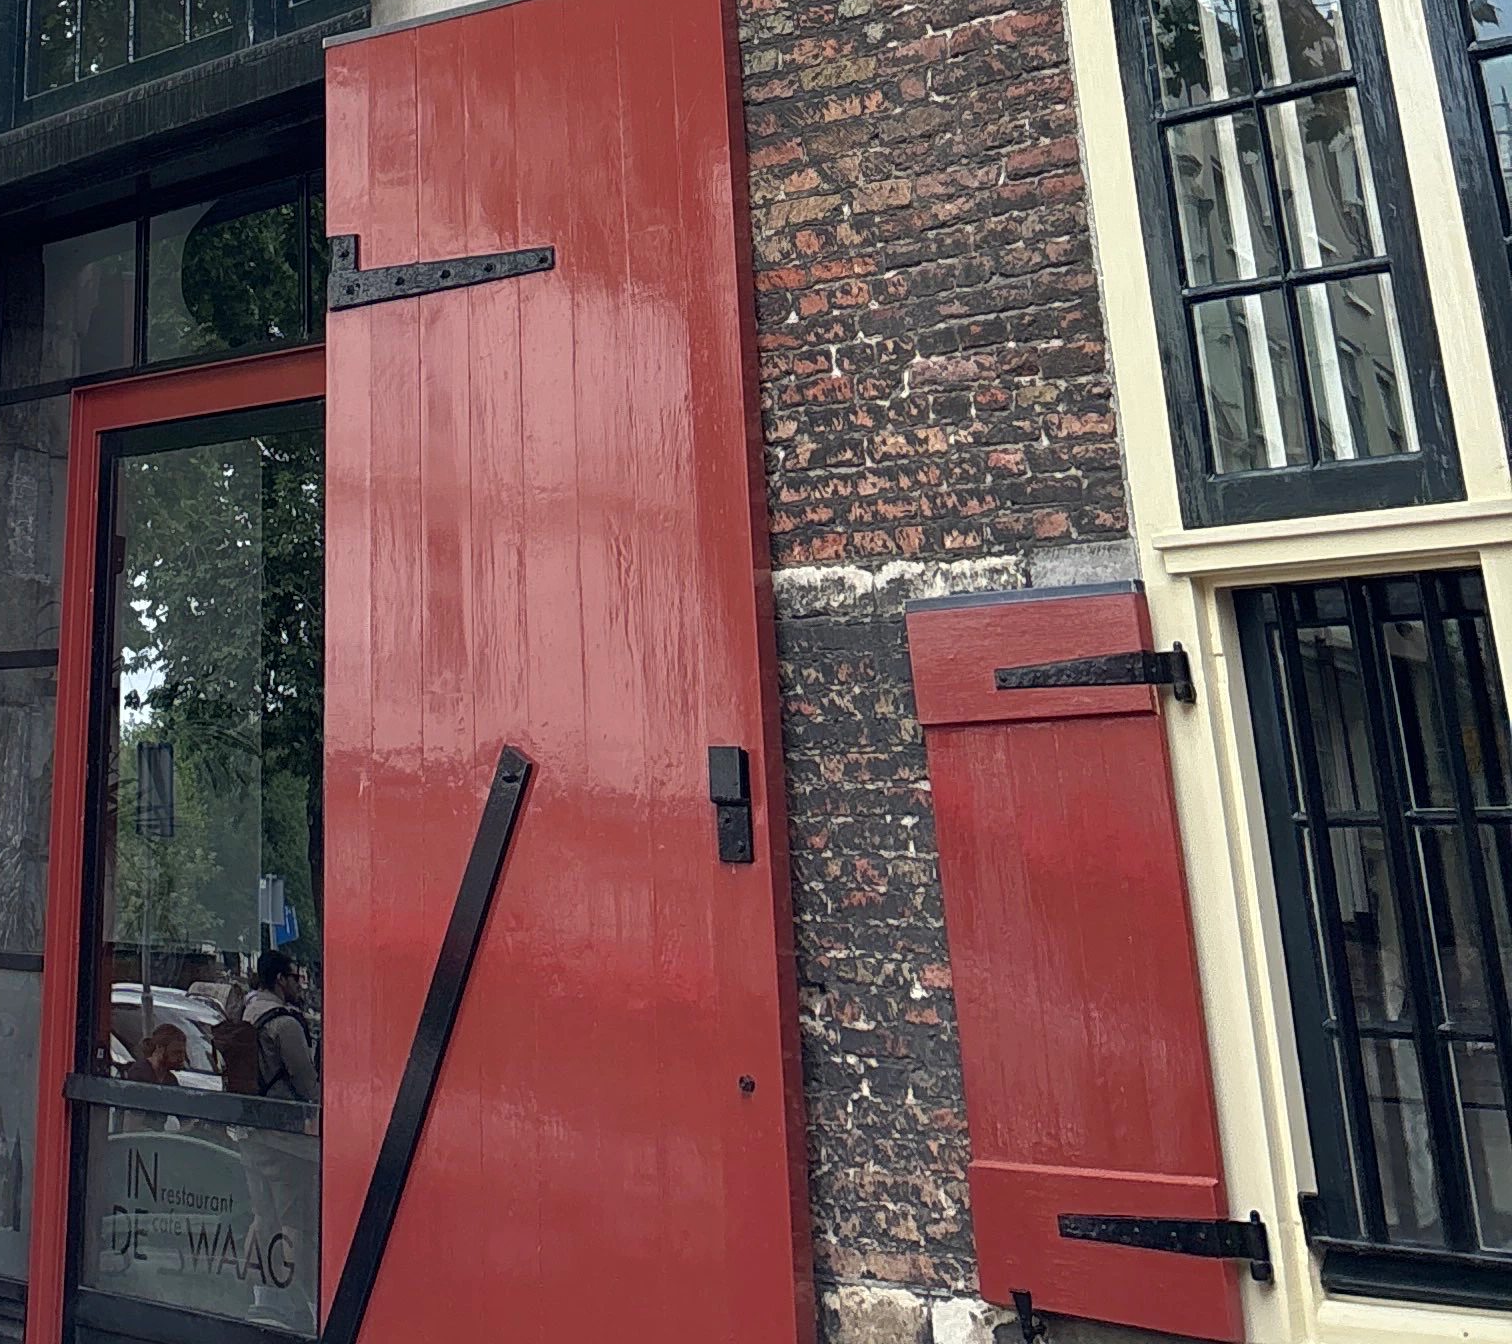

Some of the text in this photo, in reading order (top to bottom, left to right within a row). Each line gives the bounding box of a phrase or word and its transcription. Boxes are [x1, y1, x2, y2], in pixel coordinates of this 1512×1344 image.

[127, 1148, 159, 1202] IN
[161, 1185, 234, 1212] restaurant
[112, 1205, 295, 1288] DE WAAG
